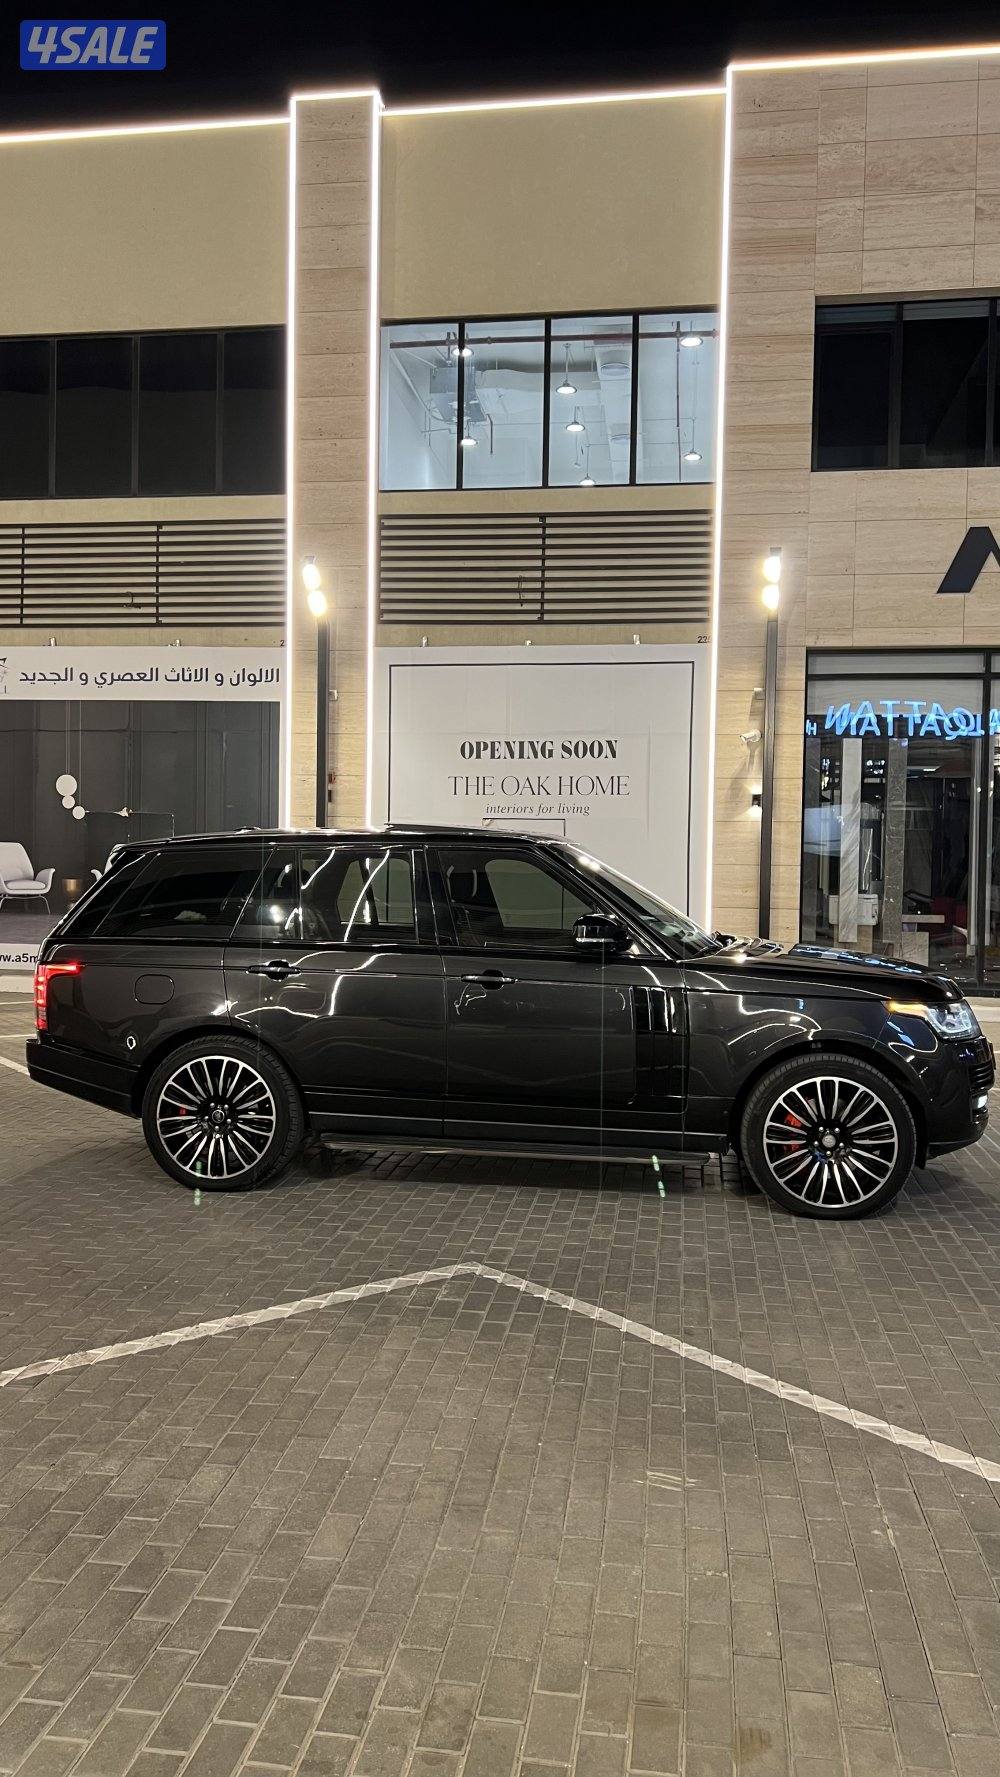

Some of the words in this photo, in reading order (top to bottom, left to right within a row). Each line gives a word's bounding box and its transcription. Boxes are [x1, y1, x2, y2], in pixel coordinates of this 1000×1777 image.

[19, 666, 74, 685] الجديد
[79, 671, 89, 686] و
[94, 666, 159, 689] العصري
[164, 666, 209, 682] الاثاث
[214, 672, 224, 686] و
[229, 667, 280, 686] الالوان
[460, 740, 554, 760] OPENING
[560, 739, 618, 759] SOON
[447, 775, 496, 796] THE
[500, 775, 552, 796] OAK
[558, 774, 631, 796] HOME
[486, 803, 534, 815] interiors
[536, 803, 554, 817] for
[557, 802, 591, 817] living
